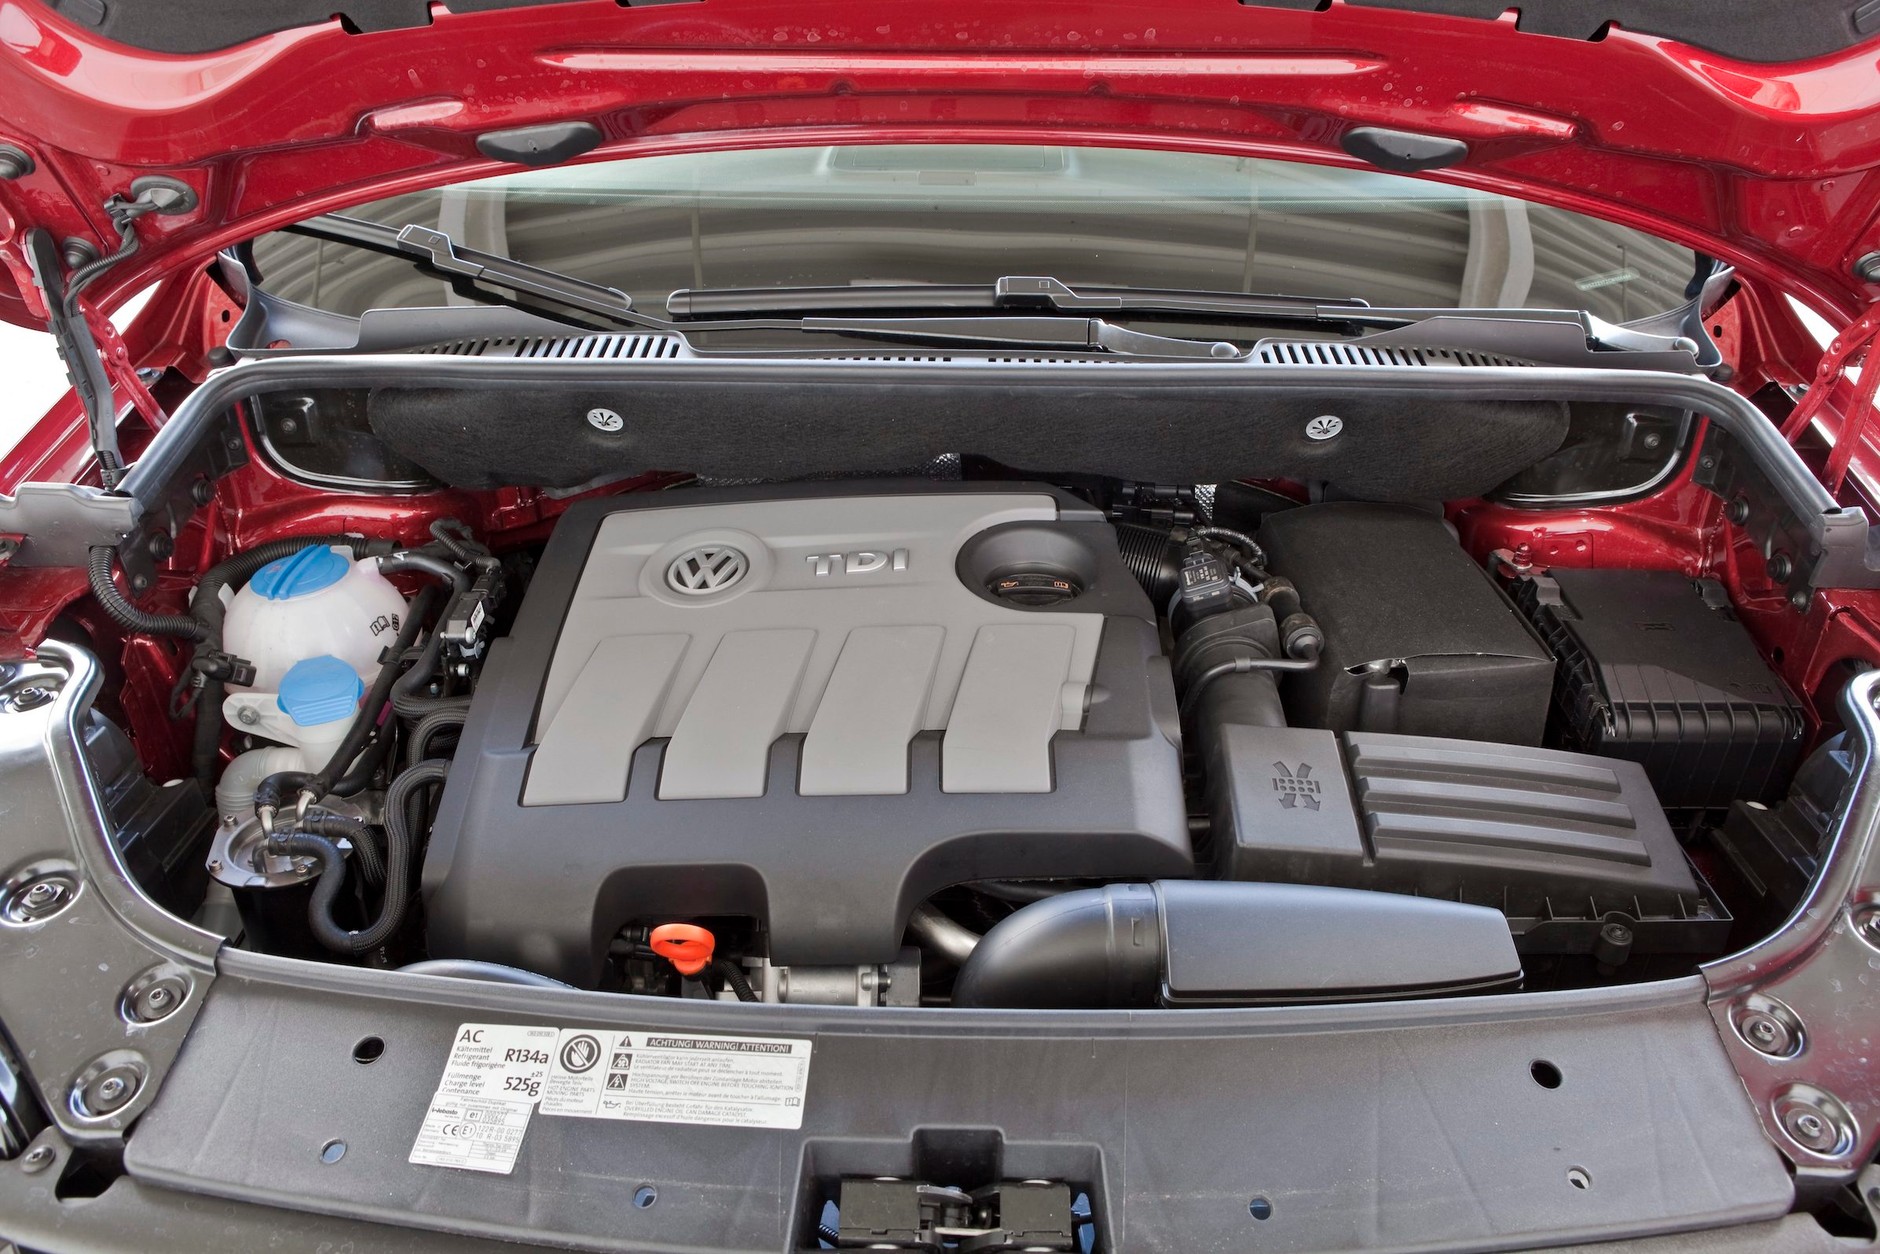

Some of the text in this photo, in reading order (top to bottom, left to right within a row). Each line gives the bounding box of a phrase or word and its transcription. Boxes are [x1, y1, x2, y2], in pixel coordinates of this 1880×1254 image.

[806, 548, 910, 577] TDI
[460, 1030, 484, 1043] AC
[457, 1045, 493, 1053] Kältemittel
[649, 1038, 789, 1052] ACHTUNG! WARNING! ATTENTION!
[453, 1053, 490, 1062] Refrigerant
[505, 1048, 549, 1064] R134a
[470, 1061, 506, 1070] frigorigène
[447, 1073, 482, 1081] Füllmenge
[444, 1080, 468, 1088] Charge
[504, 1077, 540, 1096] 525g
[442, 1087, 480, 1095] Contenance
